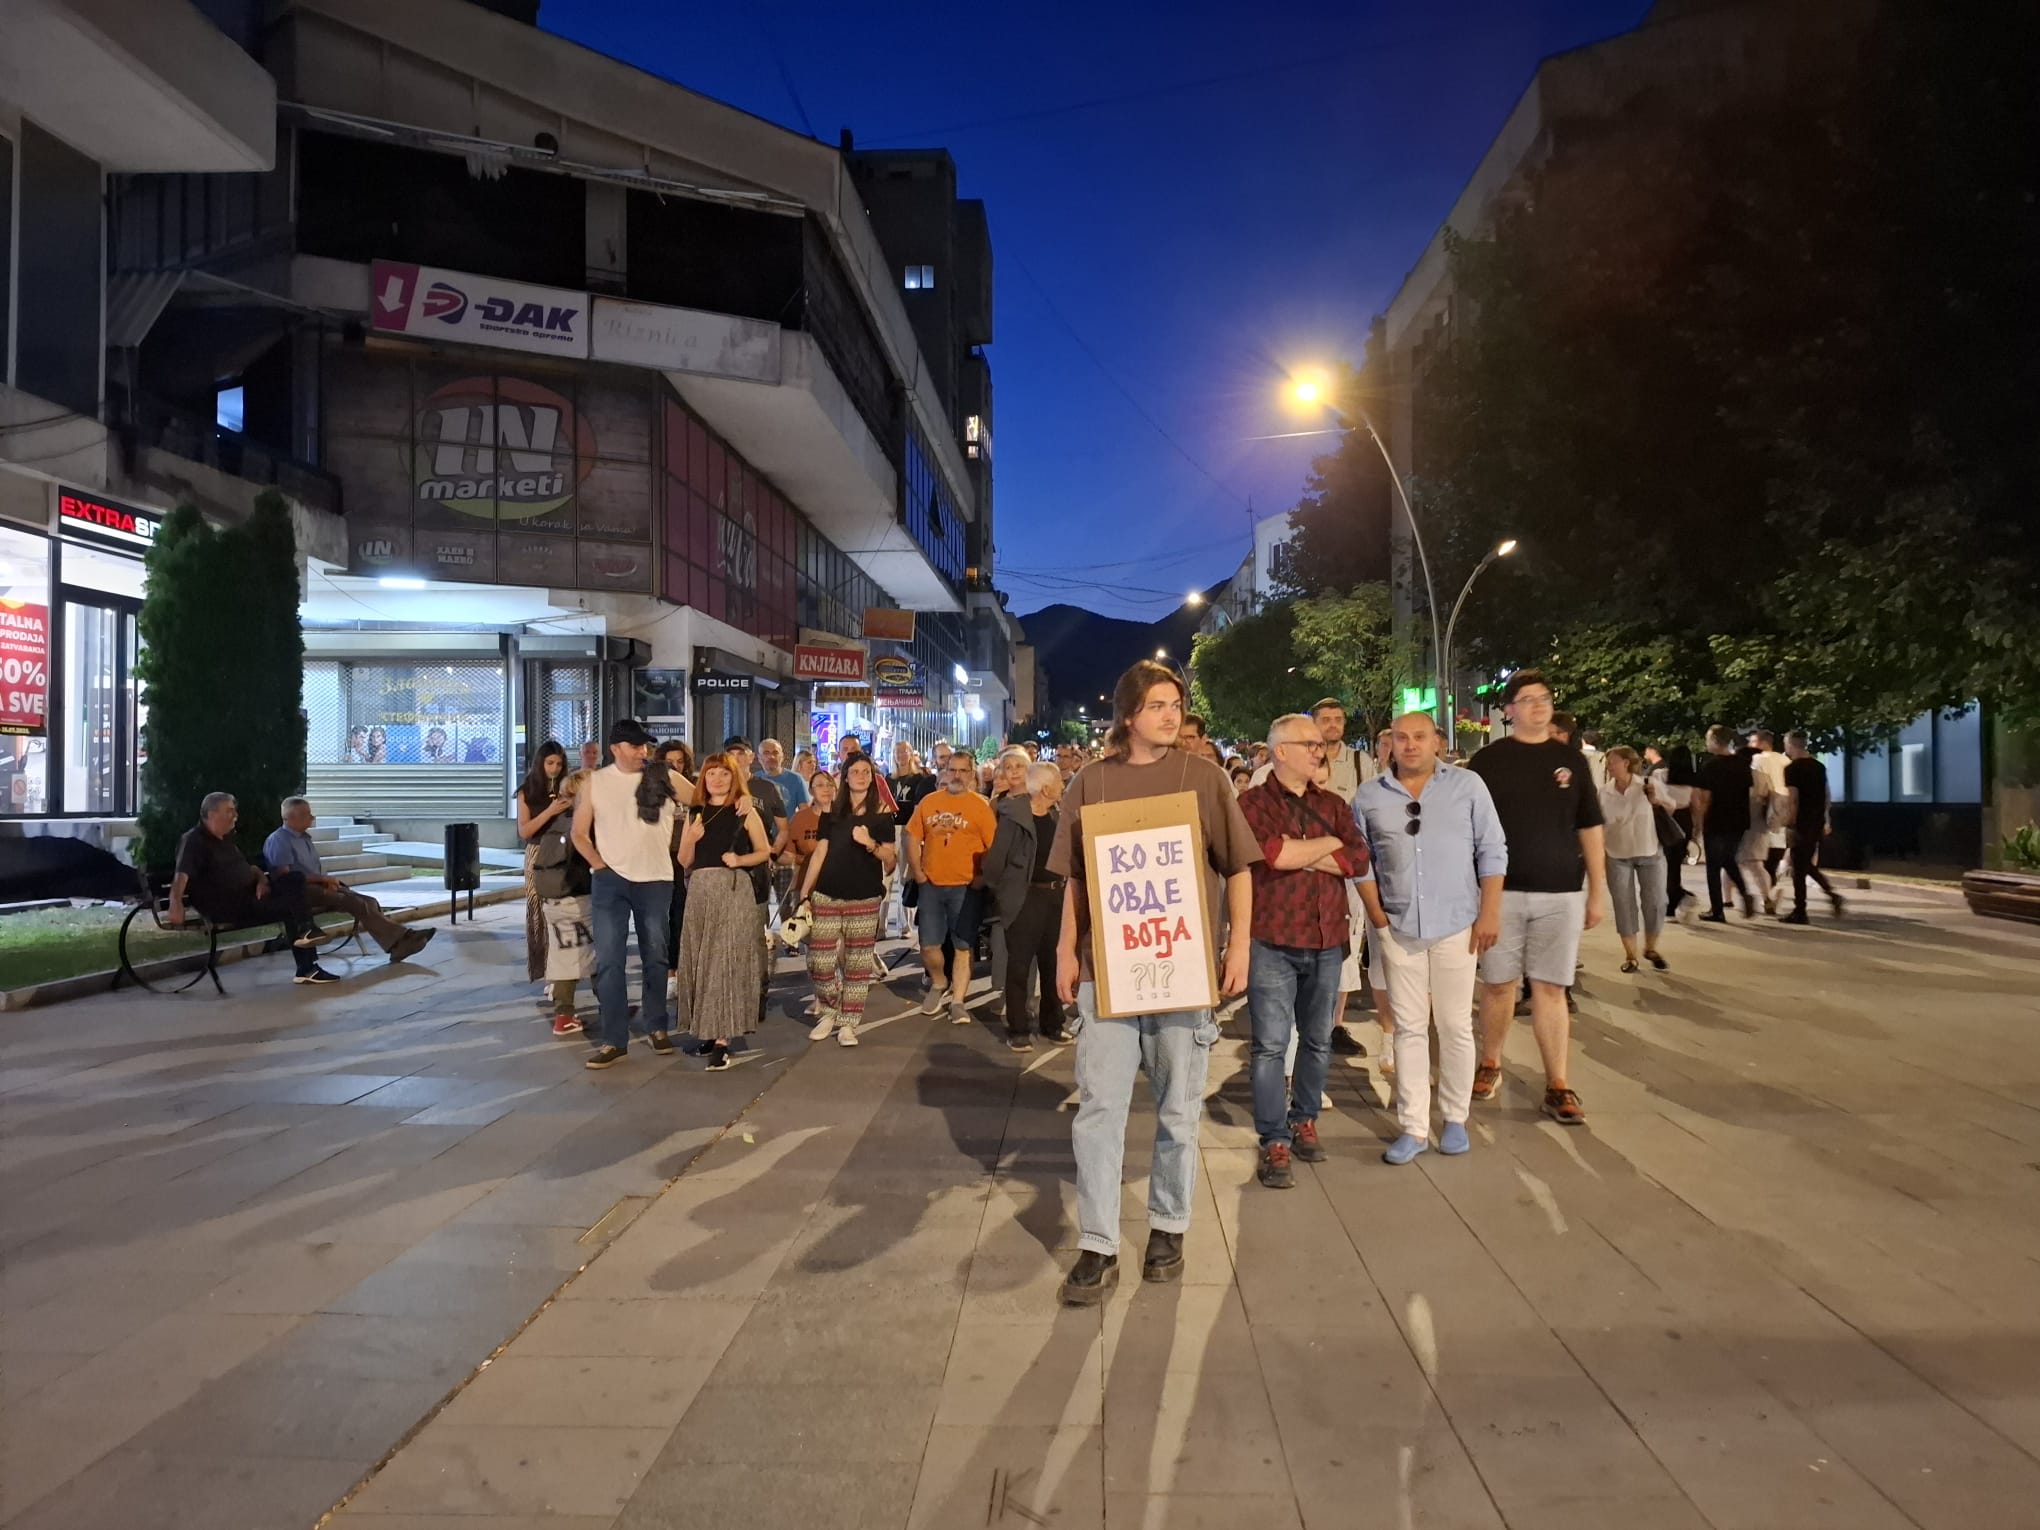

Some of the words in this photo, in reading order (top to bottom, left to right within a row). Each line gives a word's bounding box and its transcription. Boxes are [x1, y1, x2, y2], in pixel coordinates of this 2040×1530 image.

[480, 323, 529, 336] sportska
[533, 331, 574, 342] oprema
[434, 404, 559, 476] IN
[420, 472, 563, 499] marketi
[799, 652, 860, 676] KNJIŽARA
[697, 679, 749, 687] POLICE
[9, 691, 45, 715] SVE
[1109, 843, 1147, 873] КО
[1156, 840, 1184, 866] ЈЕ
[1108, 878, 1183, 915] ОВДЕ
[1122, 916, 1193, 959] ВОЂА
[1130, 960, 1175, 1001] ?!?
